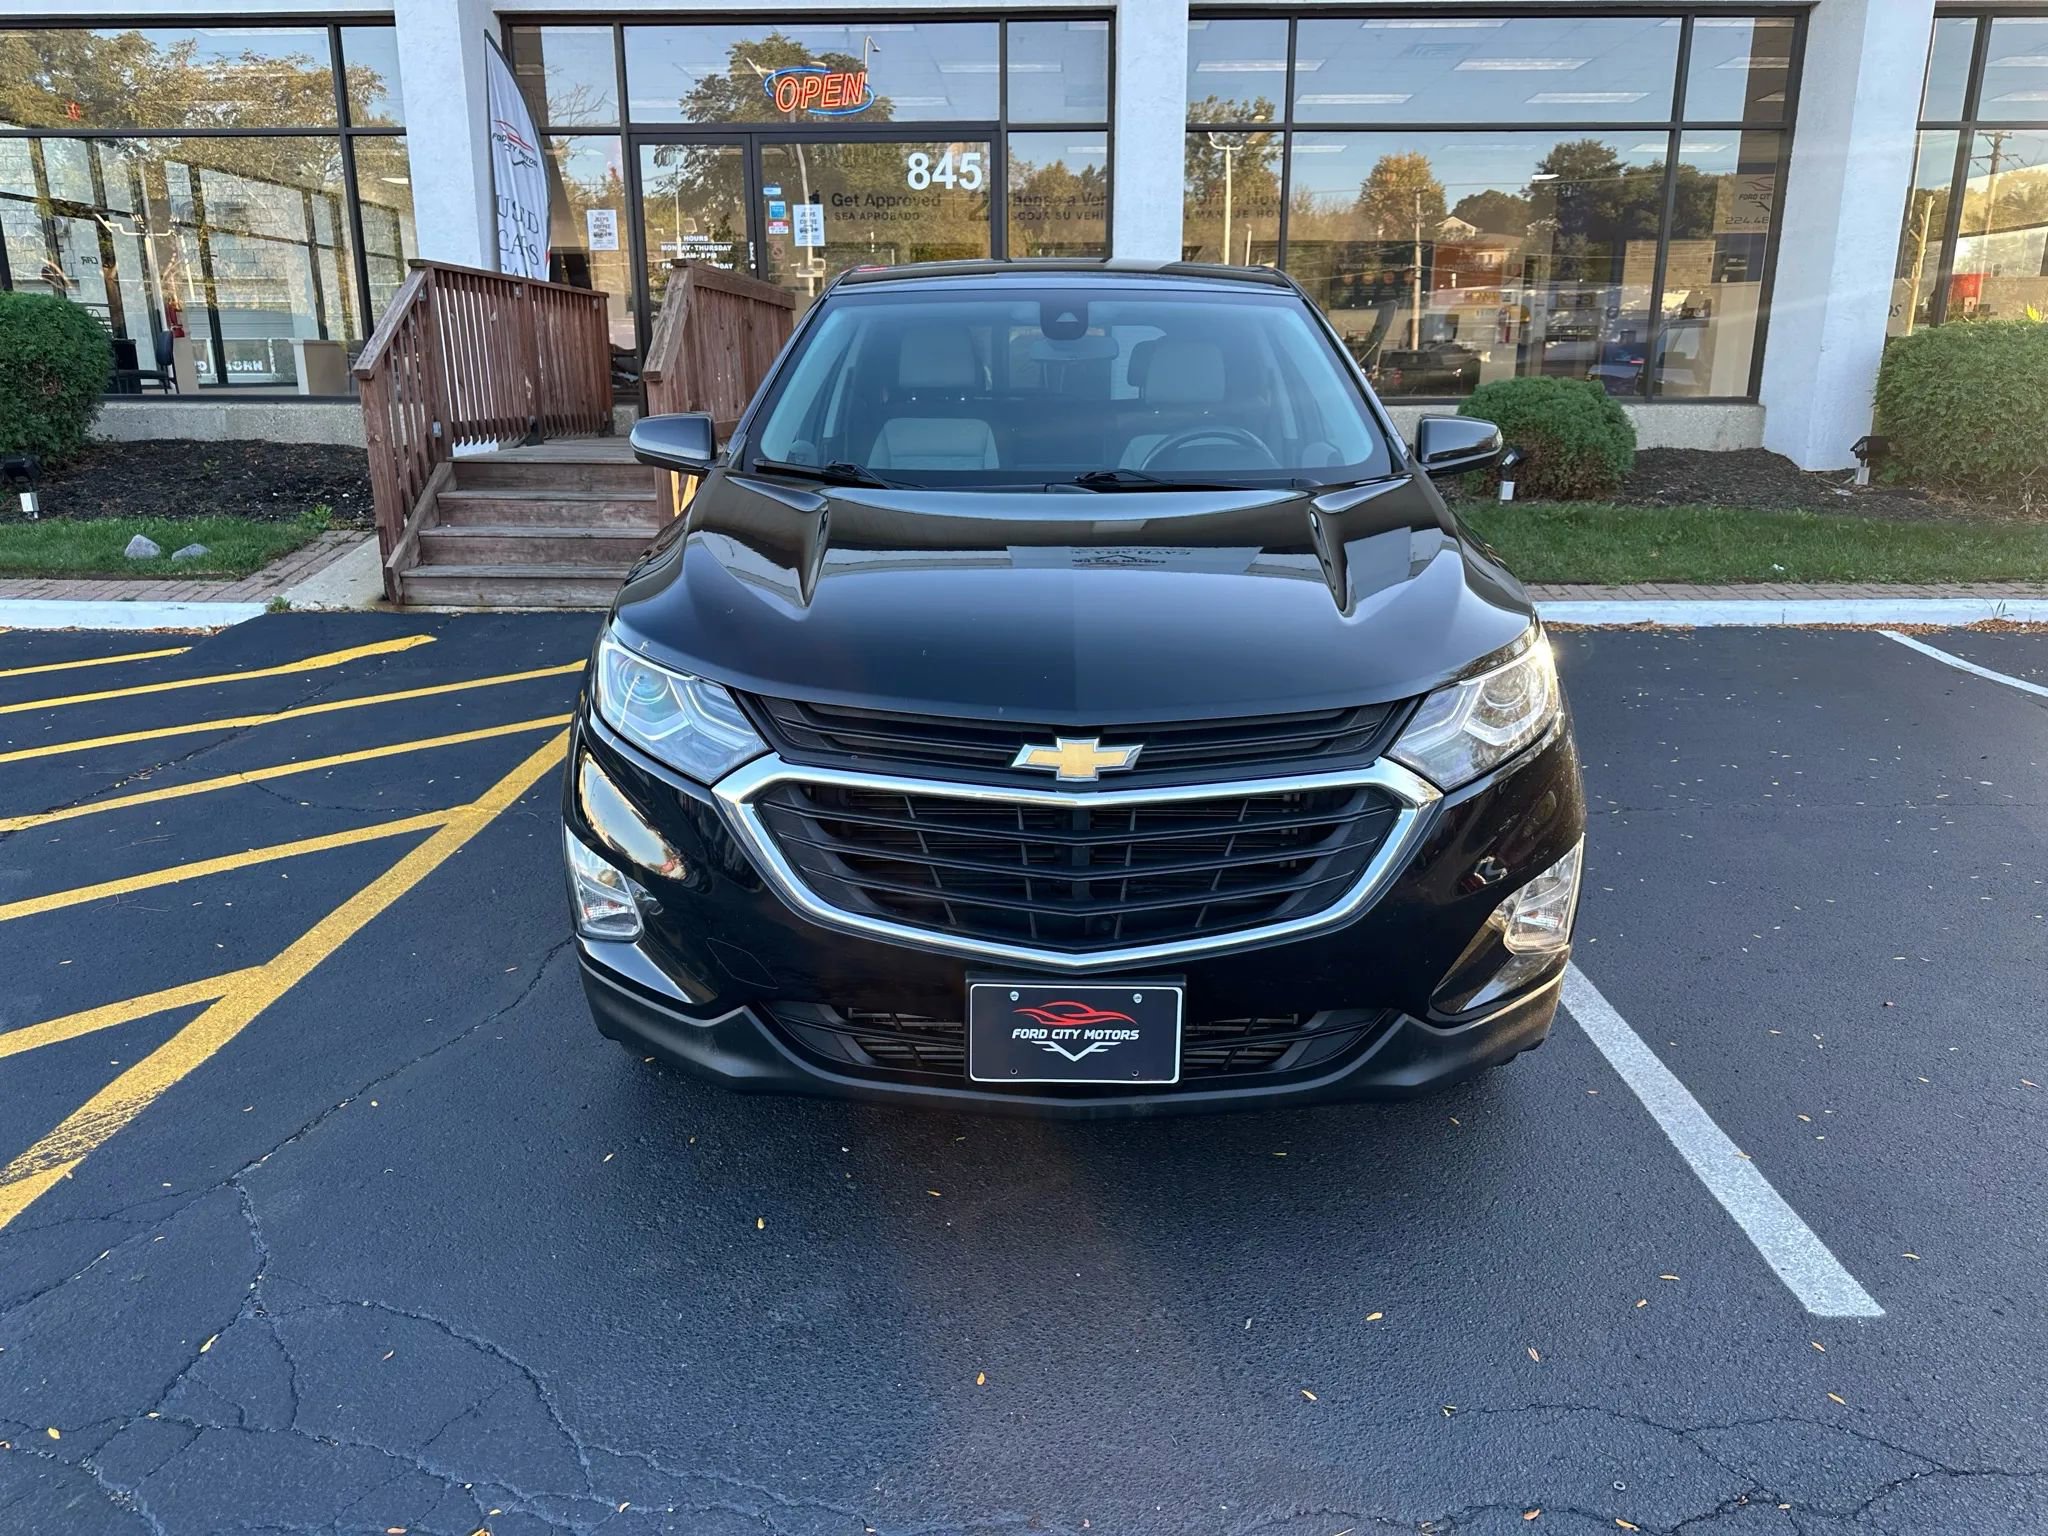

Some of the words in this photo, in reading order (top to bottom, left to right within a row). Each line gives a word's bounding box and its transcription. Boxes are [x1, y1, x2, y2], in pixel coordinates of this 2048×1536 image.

[775, 71, 865, 113] OPEN
[907, 152, 983, 190] 845
[831, 193, 859, 207] Get
[864, 193, 941, 209] Approved
[834, 211, 856, 221] SEA
[1055, 211, 1071, 221] SU
[1012, 1028, 1048, 1039] FORD
[1051, 1028, 1081, 1040] CITY
[1084, 1029, 1140, 1040] MOTORS
